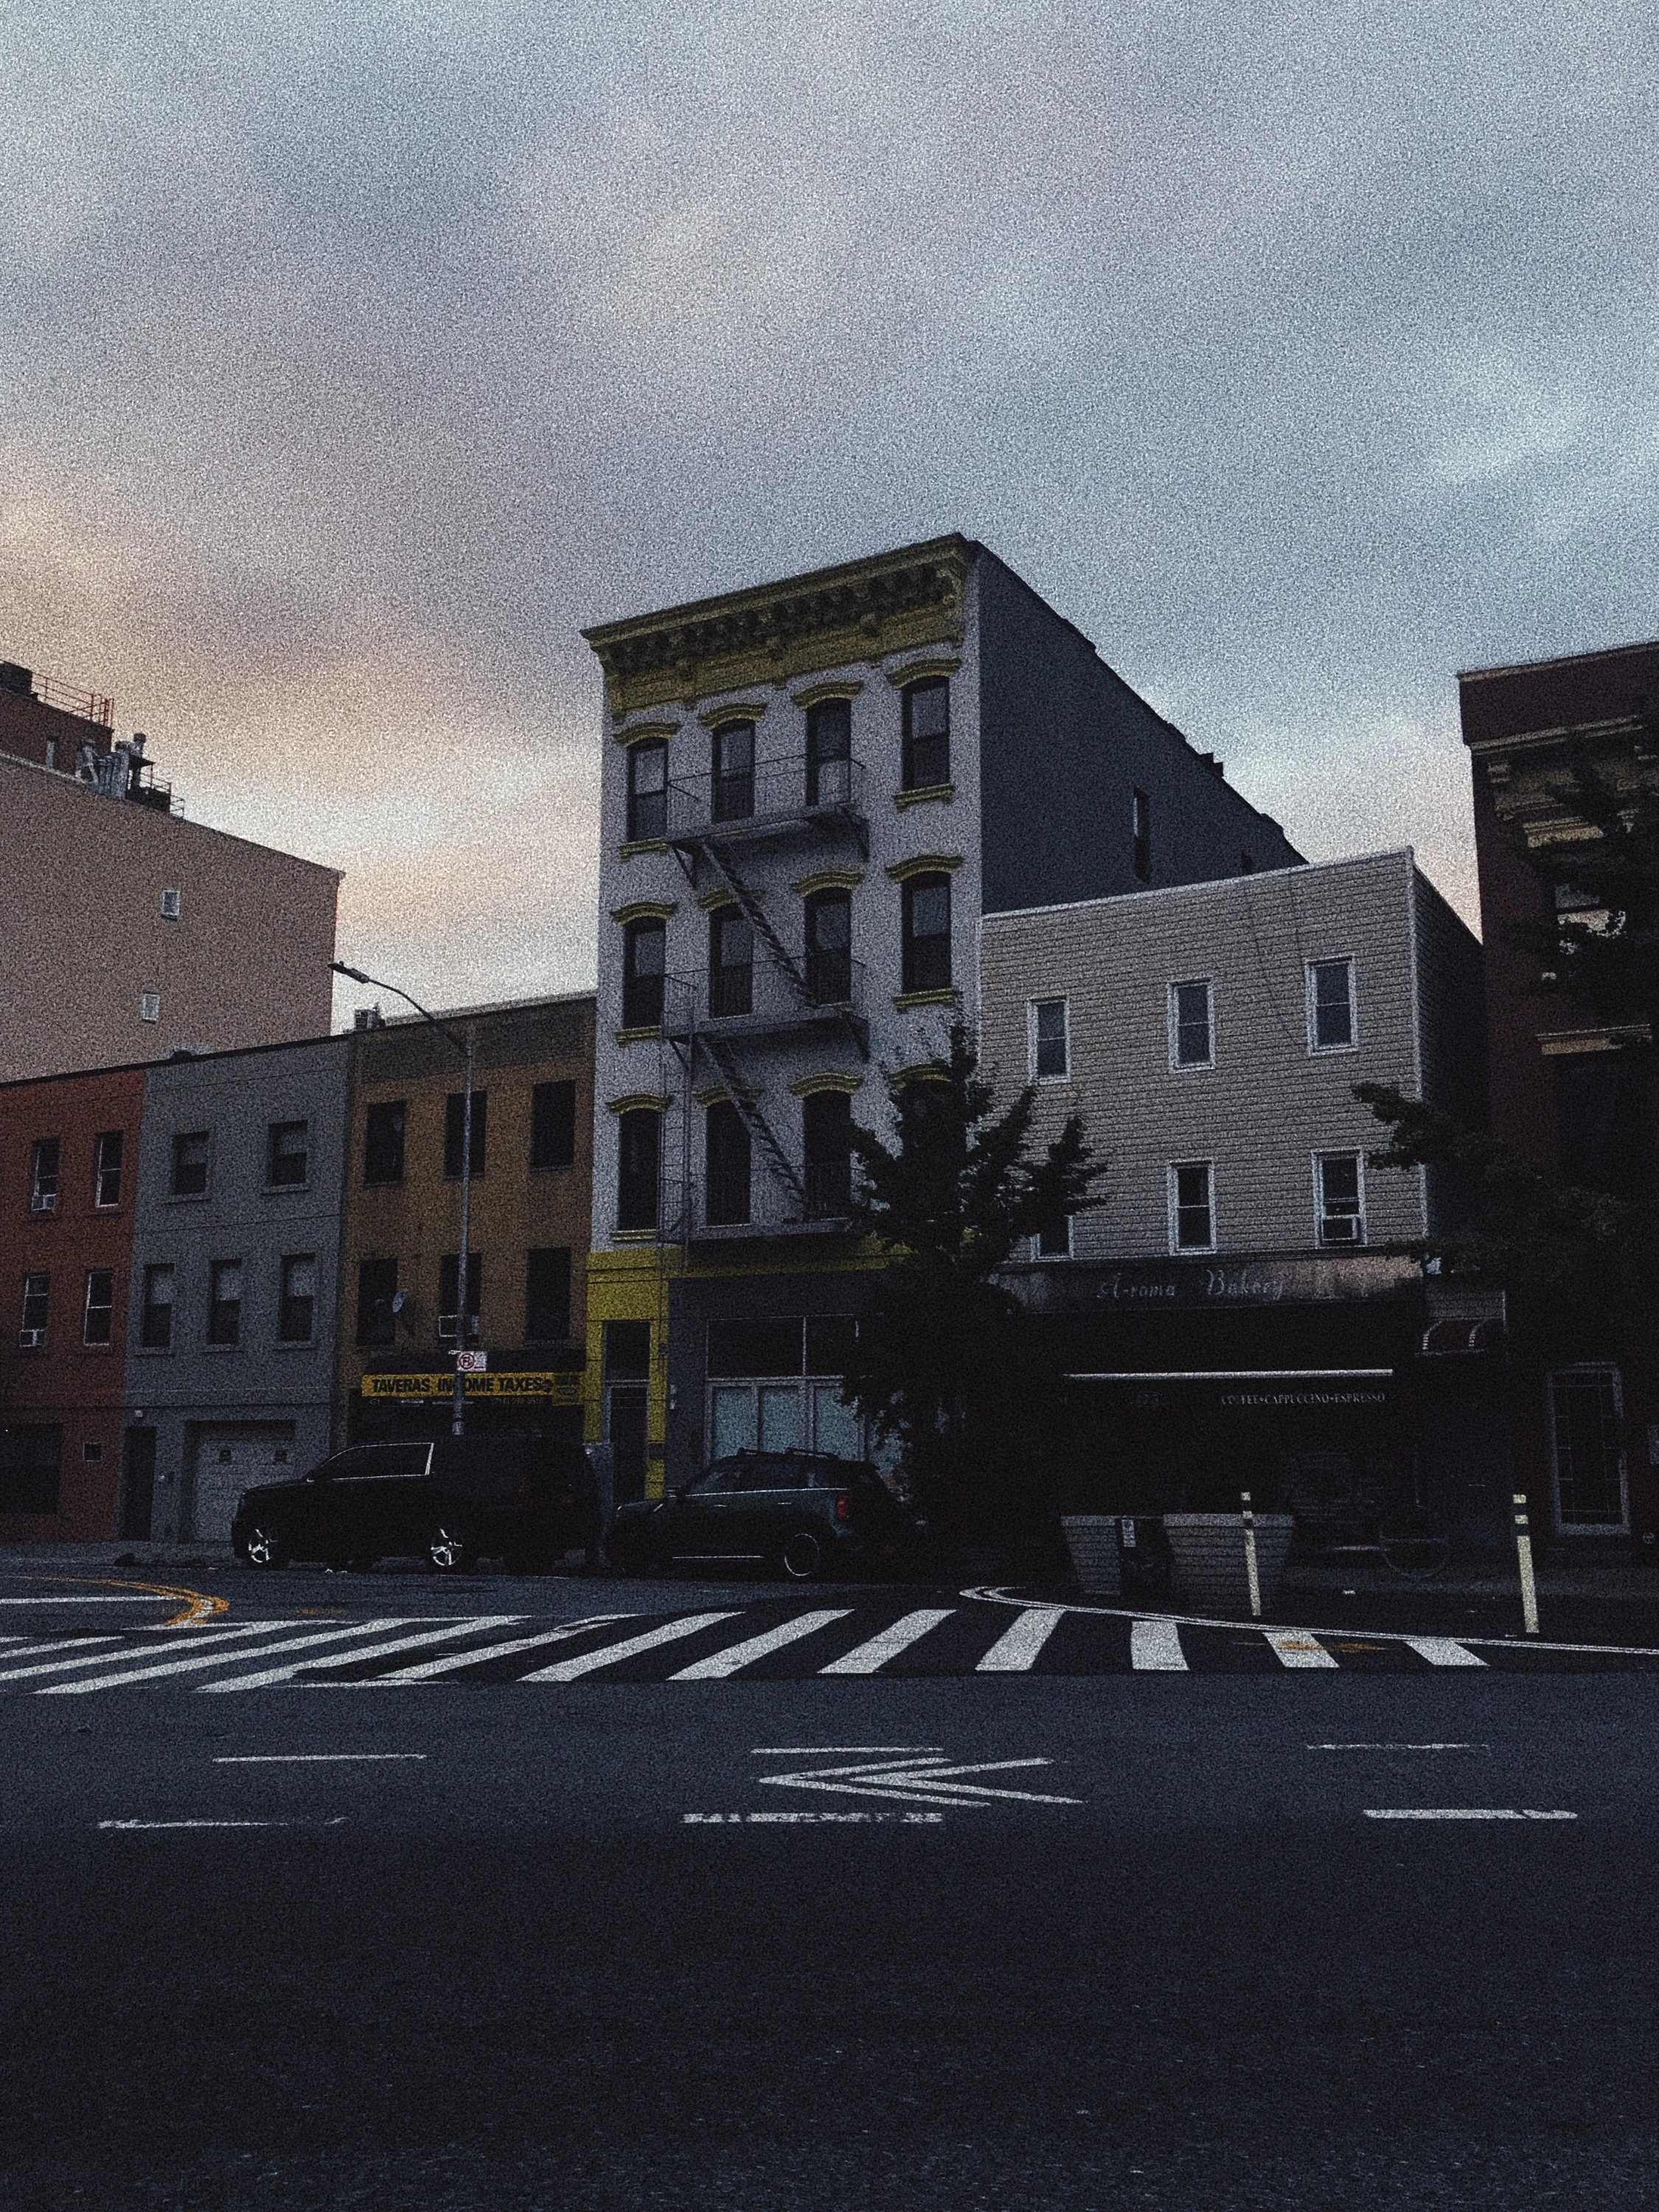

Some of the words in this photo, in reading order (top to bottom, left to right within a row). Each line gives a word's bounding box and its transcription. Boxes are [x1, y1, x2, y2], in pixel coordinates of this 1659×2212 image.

[1203, 1268, 1284, 1301] Bakery
[372, 1378, 430, 1393] TAVERAS
[438, 1377, 493, 1392] INOME
[497, 1377, 543, 1391] TAXES
